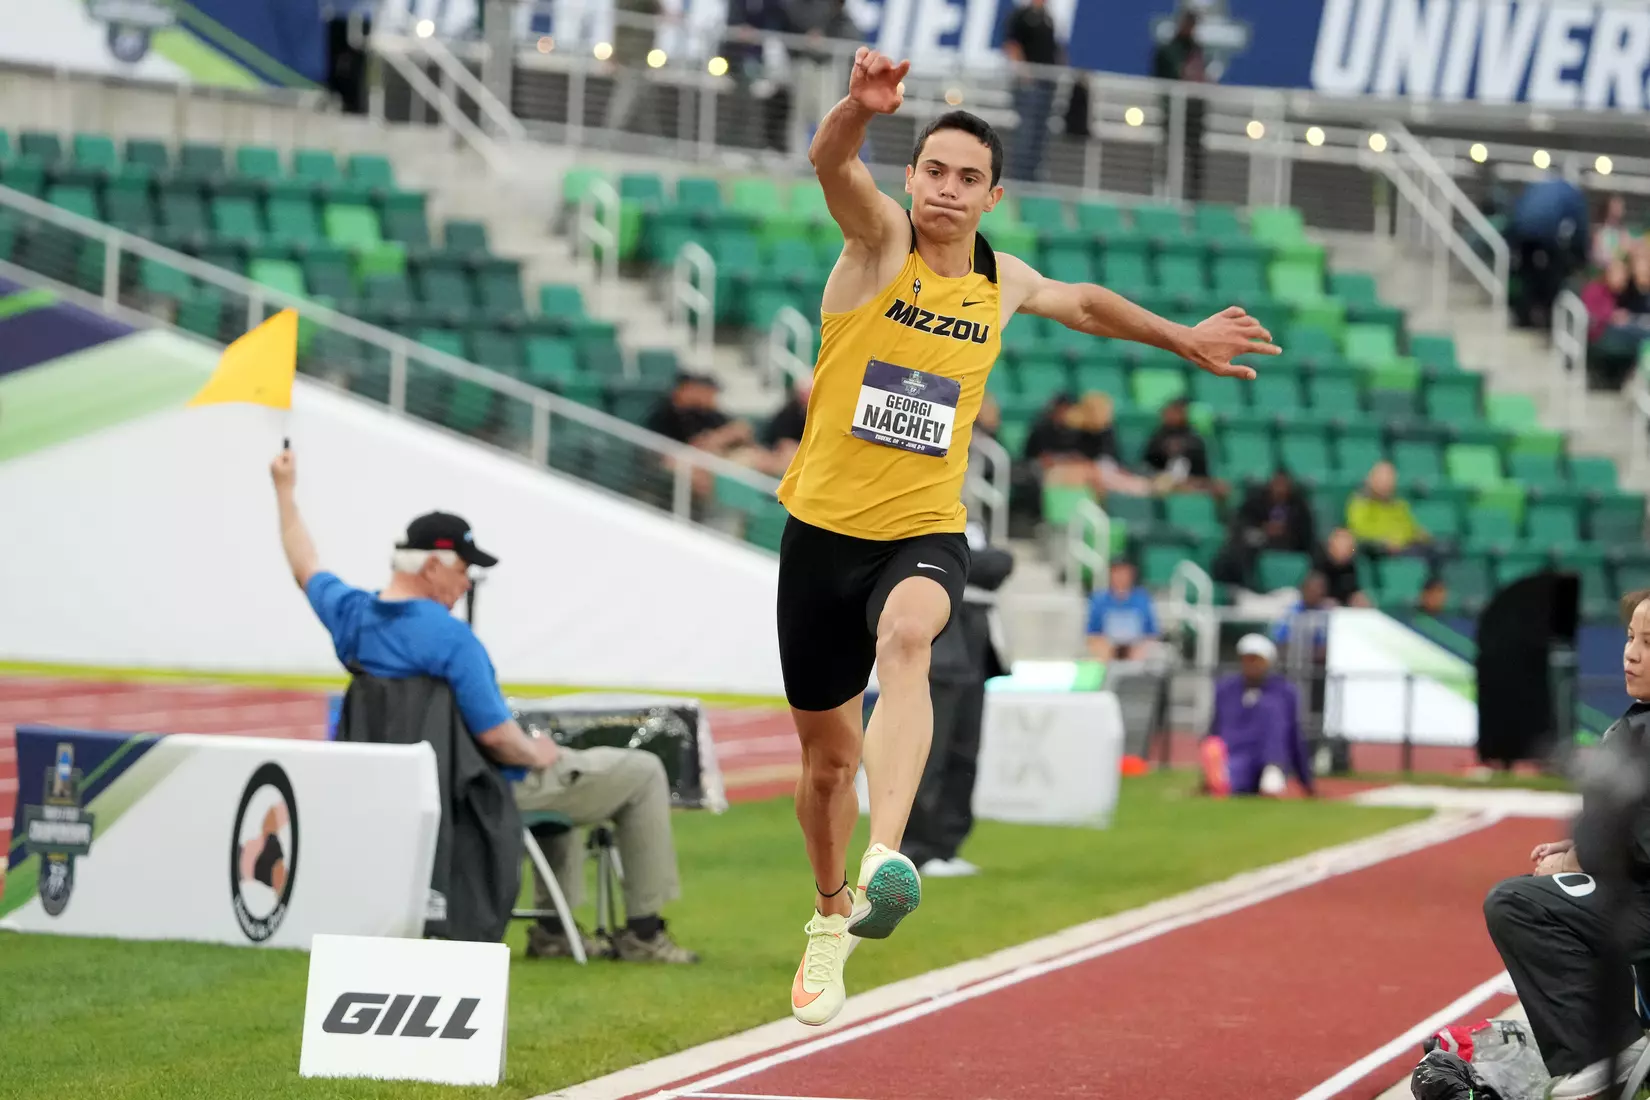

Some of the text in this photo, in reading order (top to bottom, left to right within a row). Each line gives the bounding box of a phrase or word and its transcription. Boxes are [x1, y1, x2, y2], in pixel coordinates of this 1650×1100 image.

[884, 298, 990, 344] MIZZOU
[862, 403, 946, 444] NACHEV
[885, 394, 932, 417] GEORGI
[321, 991, 481, 1040] GILL
